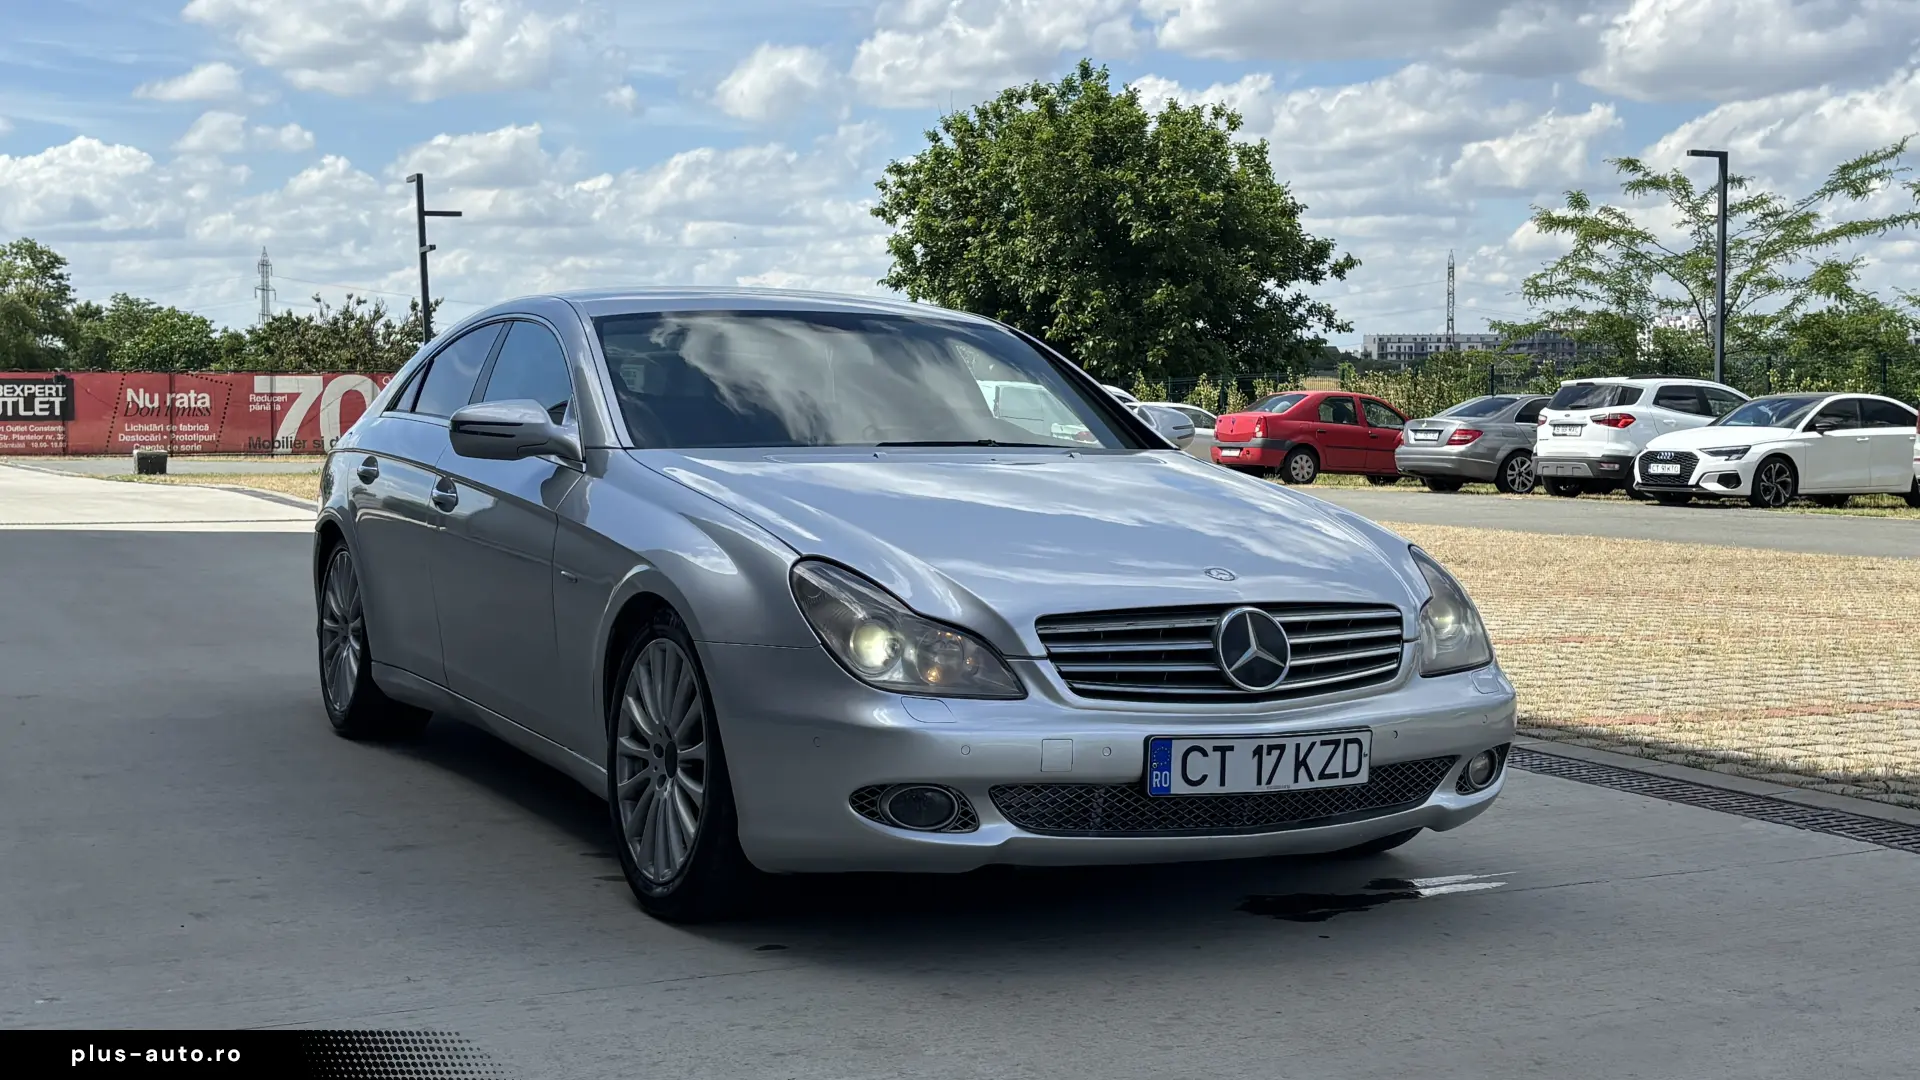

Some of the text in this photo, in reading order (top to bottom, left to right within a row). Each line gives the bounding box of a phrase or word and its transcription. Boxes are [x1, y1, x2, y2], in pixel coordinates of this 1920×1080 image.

[0, 397, 66, 416] TLET
[126, 388, 211, 408] Nu rata
[249, 394, 287, 402] Reduceri
[249, 403, 271, 412] până
[248, 435, 307, 450] Mobilier
[1181, 738, 1363, 787] CT 17 KZD
[1152, 771, 1170, 788] RO
